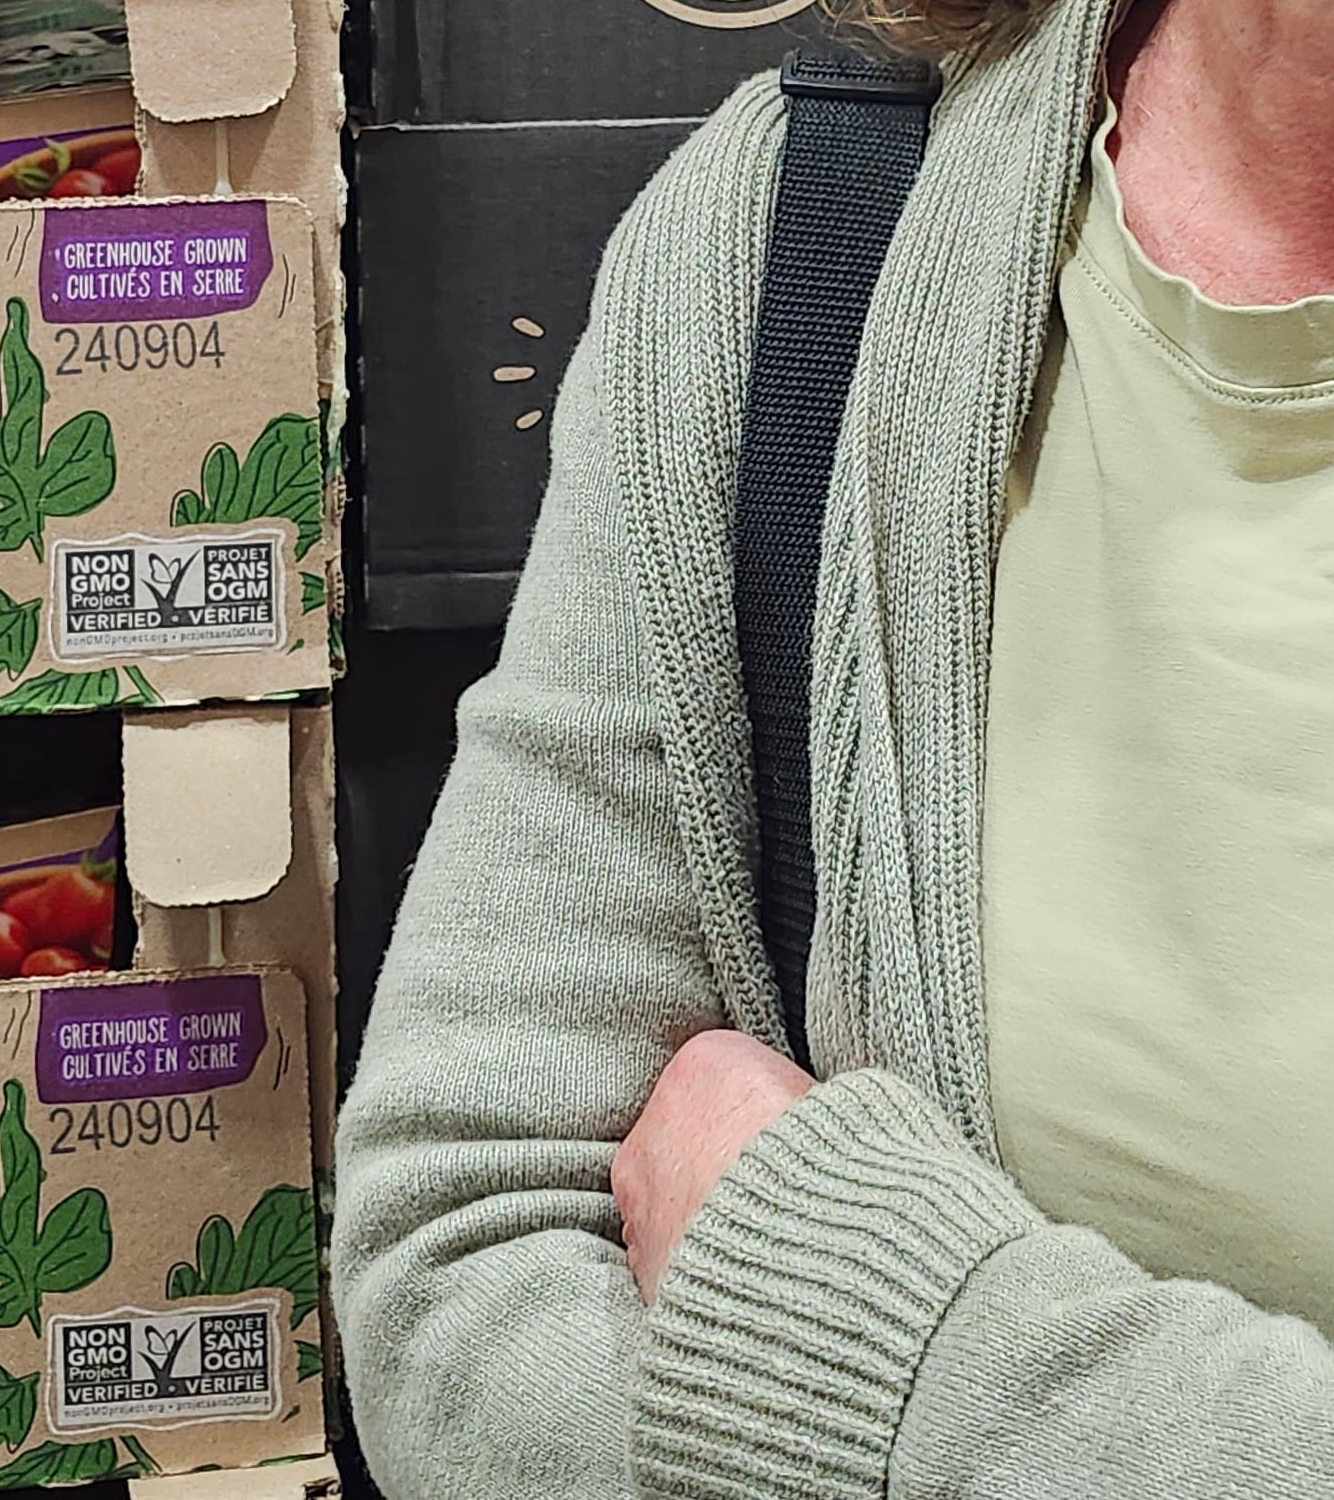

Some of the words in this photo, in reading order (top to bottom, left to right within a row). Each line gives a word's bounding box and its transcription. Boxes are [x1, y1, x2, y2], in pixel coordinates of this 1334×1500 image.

[64, 240, 174, 269] GREENHOUSE
[184, 238, 247, 265] GROWN
[67, 268, 151, 301] CULTIVÉS
[160, 271, 183, 297] EN
[194, 268, 245, 296] SERRE
[55, 321, 226, 375] 240904
[71, 554, 129, 574] NON
[207, 547, 268, 561] PROJET
[207, 562, 269, 581] SANS
[70, 574, 131, 594] GMO
[207, 581, 268, 601] OGM
[71, 592, 131, 610] Project
[69, 612, 162, 631] VERIFIED
[59, 1016, 169, 1049] GREENHOUSE
[178, 1012, 242, 1041] GROWN
[62, 1046, 146, 1080] CULTIVÉS
[154, 1046, 179, 1074] EN
[186, 1043, 239, 1072] SERRE
[49, 1096, 221, 1155] 240904
[204, 1317, 264, 1332] PROJET
[68, 1327, 126, 1348] NON
[204, 1330, 265, 1351] SANS
[68, 1346, 127, 1367] GMO
[204, 1350, 264, 1371] OGM
[69, 1365, 128, 1384] Project
[67, 1382, 158, 1403] VERIFIED
